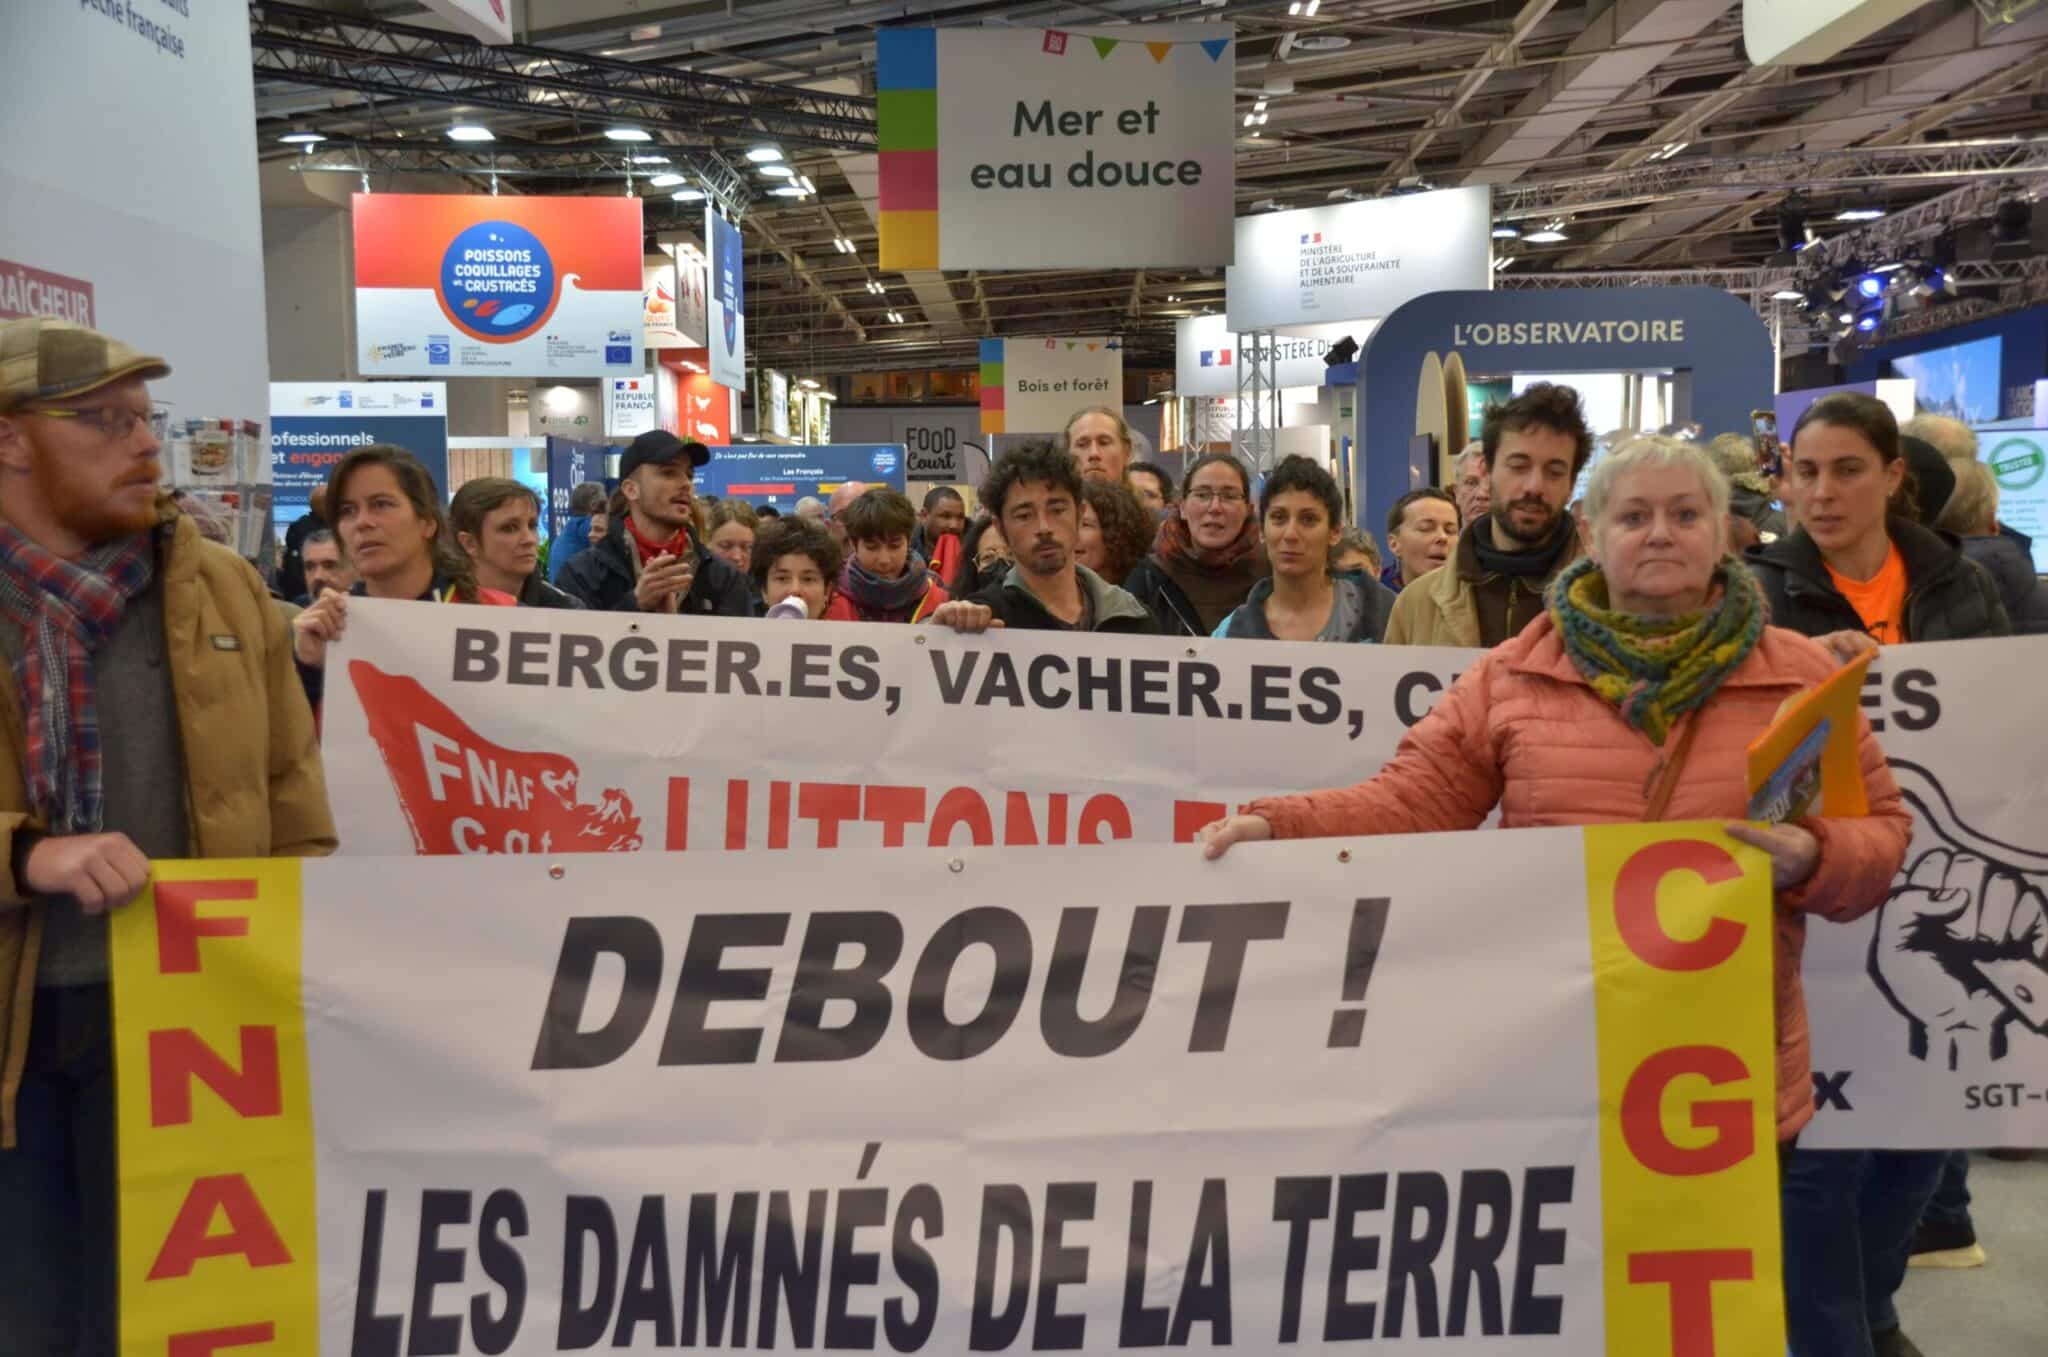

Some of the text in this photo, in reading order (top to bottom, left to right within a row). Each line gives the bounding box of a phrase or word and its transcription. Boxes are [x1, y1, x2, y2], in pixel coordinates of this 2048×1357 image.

[126, 0, 185, 59] française
[1013, 100, 1160, 137] Mer et
[970, 150, 1203, 189] eau douce
[464, 249, 531, 263] POISSONS
[1300, 244, 1343, 257] MINISTÈRE
[1300, 251, 1376, 268] DE L'AGRICULTURE
[455, 264, 542, 278] COQUILLAGES
[1324, 266, 1334, 276] LA
[1336, 259, 1400, 274] SOUVERAINETÉ
[465, 278, 537, 293] CRUSTACÉS
[1300, 275, 1354, 288] ALIMENTAIRE
[1453, 319, 1685, 346] L'OBSERVATOIRE
[1018, 378, 1109, 393] Bois et forêt
[271, 431, 374, 446] ofessionnels
[906, 427, 956, 454] FOOD
[907, 451, 957, 471] Court
[452, 627, 902, 716] BERGER.ES,
[928, 648, 1364, 741] VACHER.ES,
[414, 719, 535, 811] FNAF
[530, 900, 1292, 1071] DEBOUT
[145, 878, 295, 1357] FNA
[350, 1141, 1576, 1357] LES DAMNÉS DE LA TERRE
